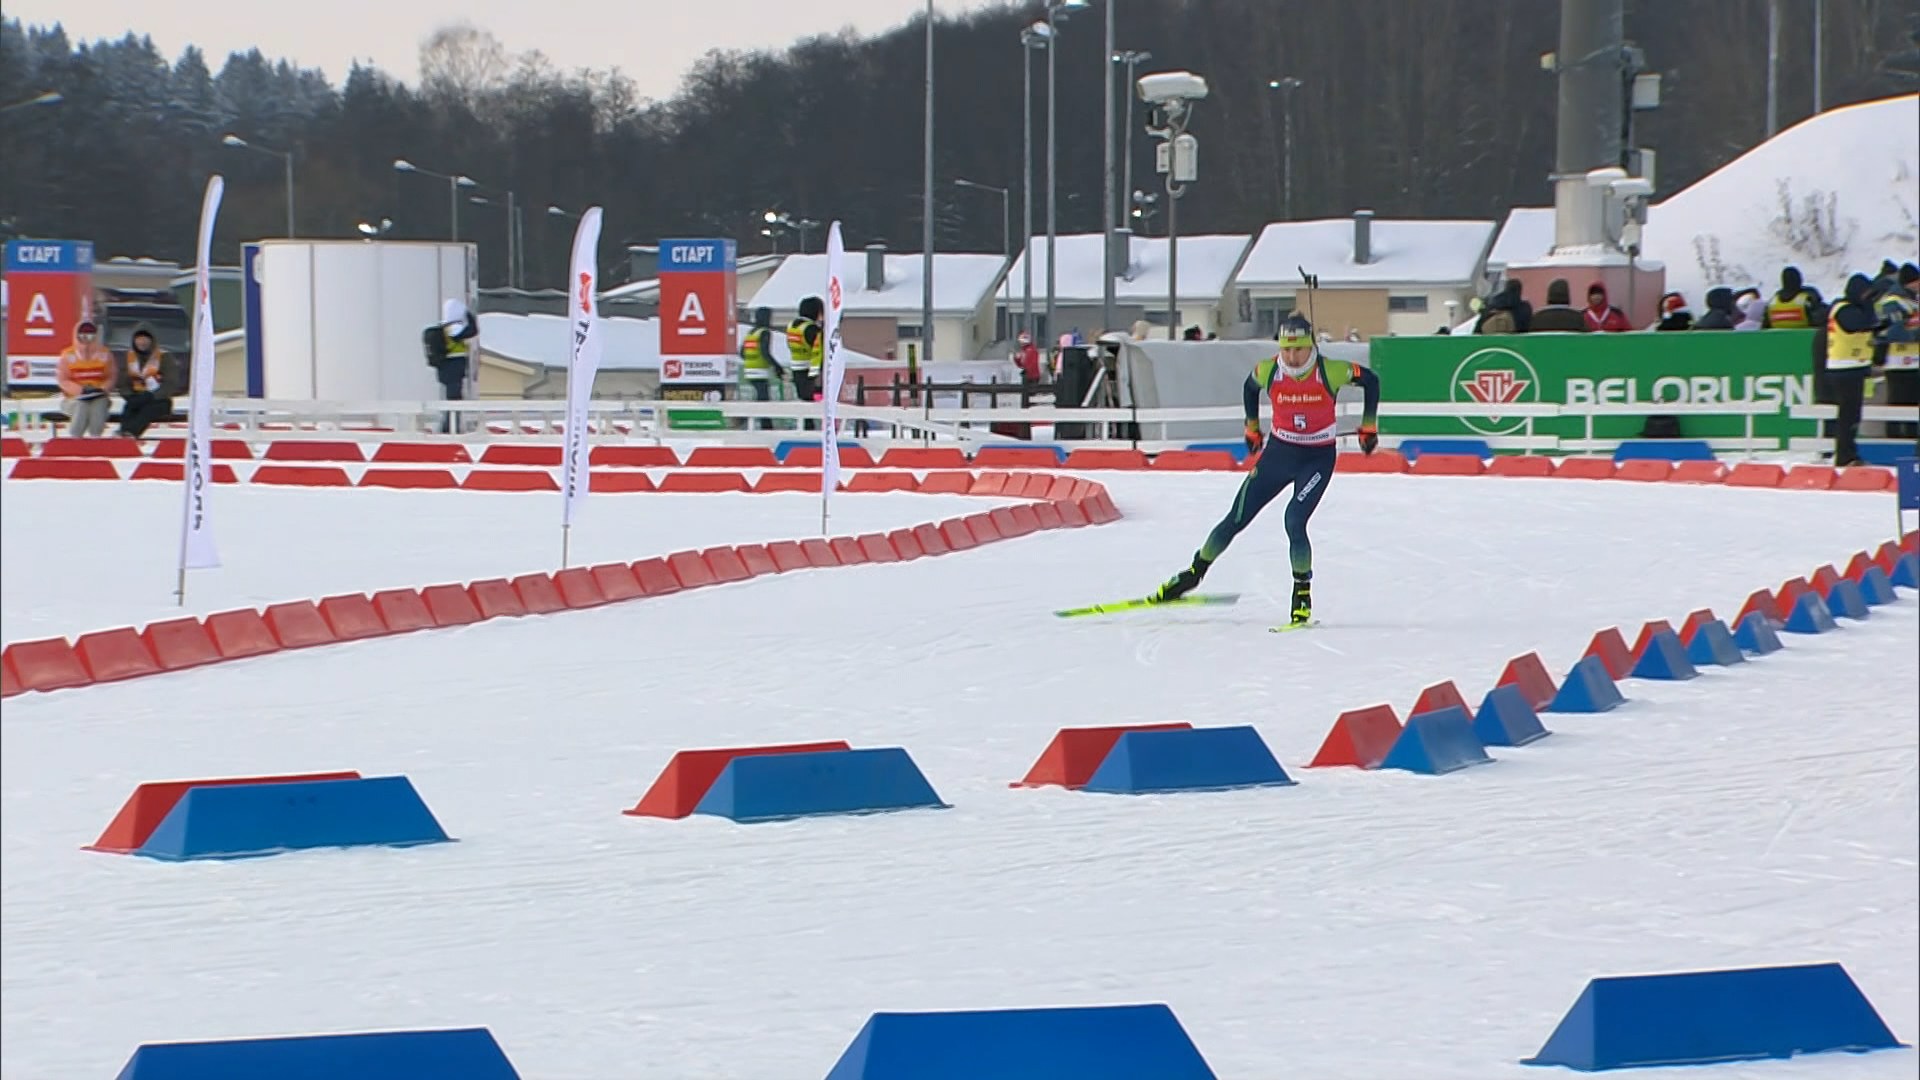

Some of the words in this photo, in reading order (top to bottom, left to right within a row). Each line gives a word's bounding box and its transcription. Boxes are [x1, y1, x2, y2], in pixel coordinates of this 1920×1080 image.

[18, 246, 61, 262] СТАРТ
[671, 246, 714, 263] СТАРТ
[1294, 415, 1306, 430] 5
